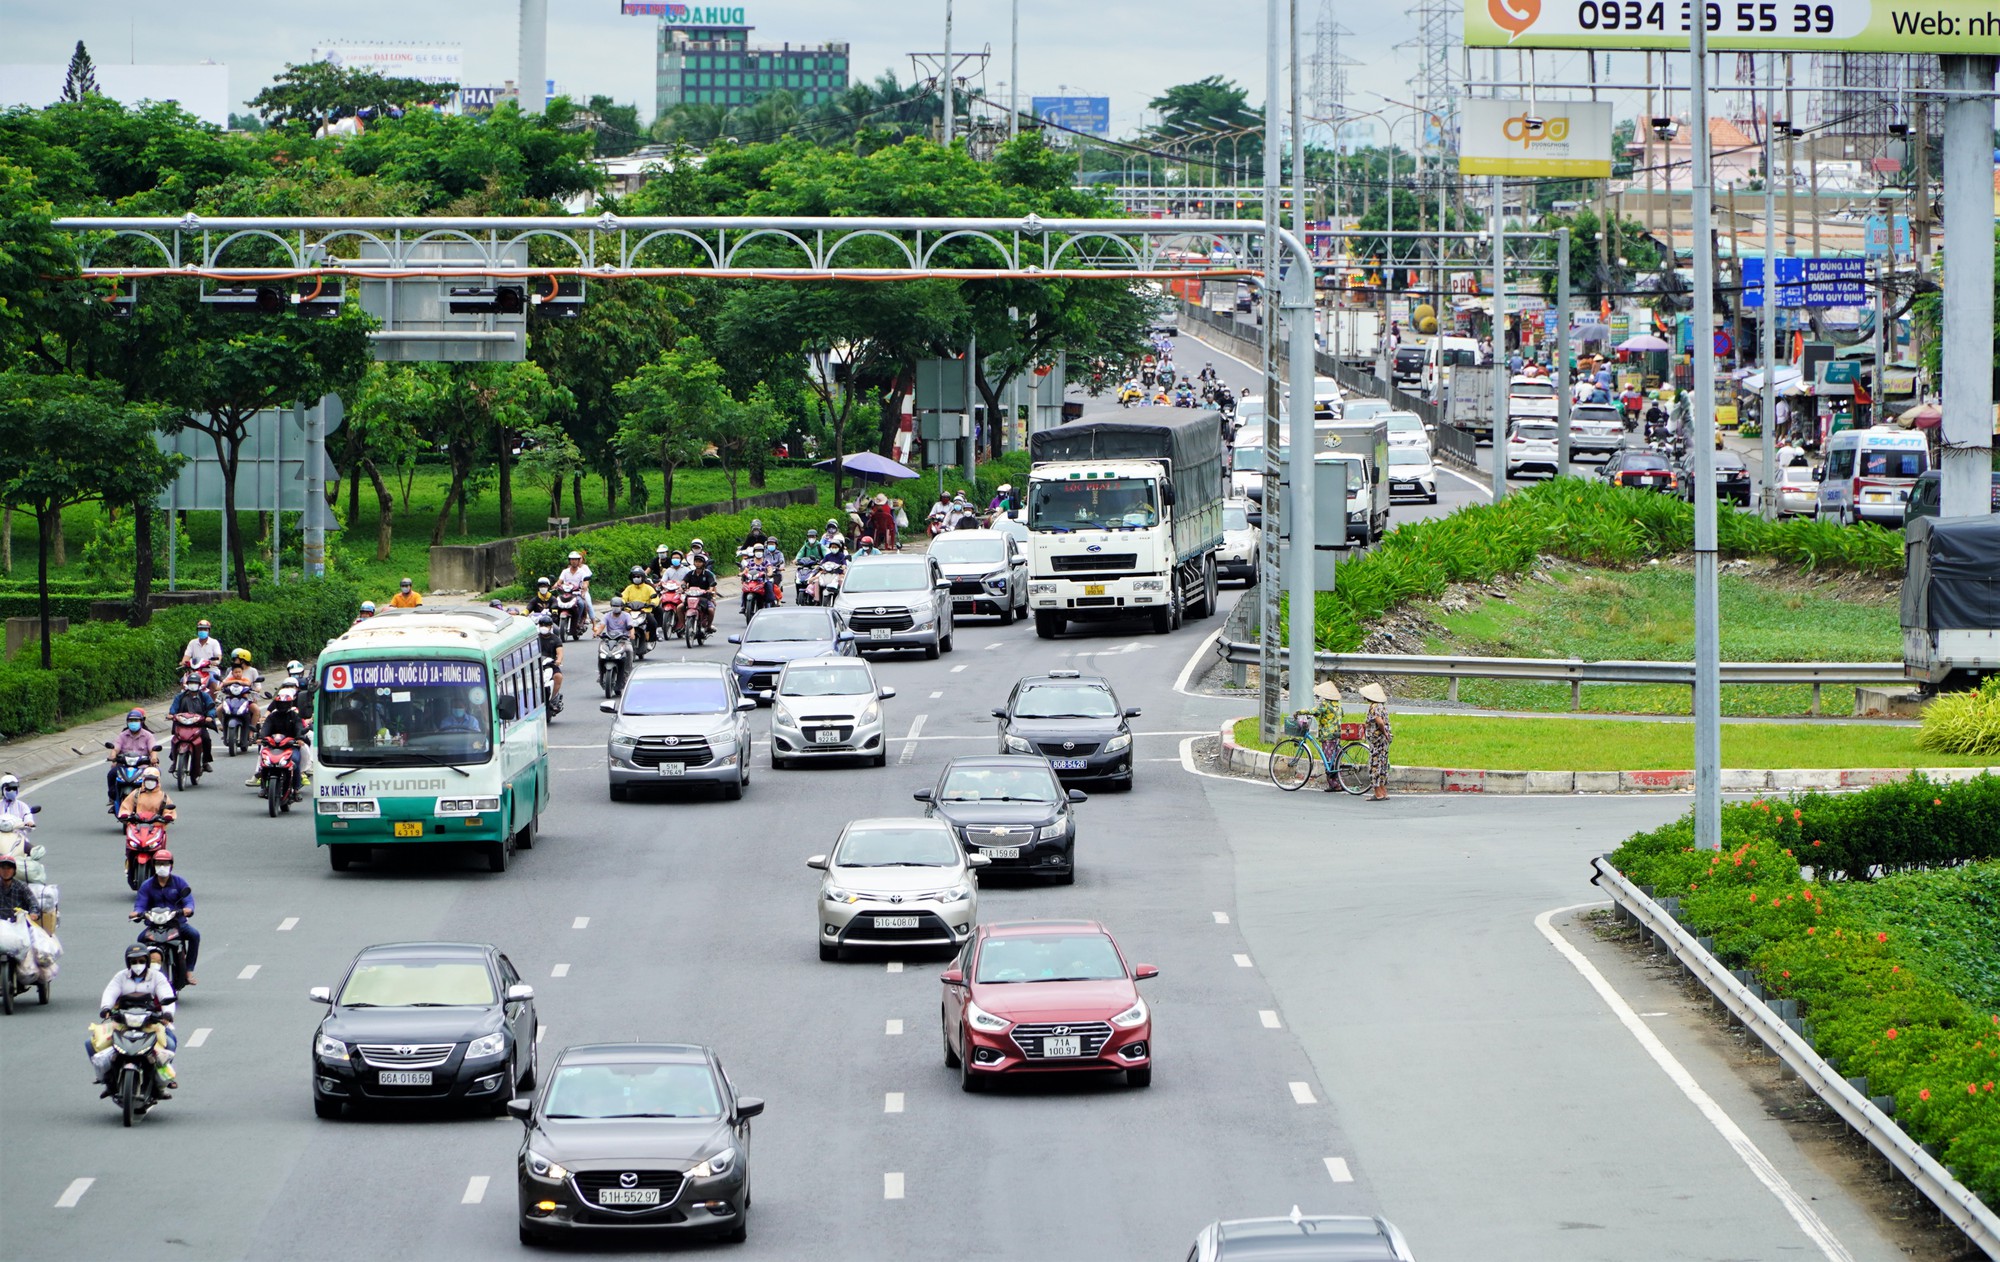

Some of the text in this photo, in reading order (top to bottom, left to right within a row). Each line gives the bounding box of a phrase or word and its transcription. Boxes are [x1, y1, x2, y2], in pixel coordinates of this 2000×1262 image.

[1578, 1, 1834, 33] 0934 39 55 39
[1892, 11, 1961, 36] Web:
[390, 53, 413, 61] LONG
[1809, 260, 1861, 271] ĐI ĐÚNG LÀN
[1837, 283, 1859, 293] VẠCH
[1807, 292, 1824, 302] SƠN
[1826, 293, 1843, 302] QUY
[1843, 293, 1863, 304] ĐỊNH
[1867, 437, 1922, 447] SOLATI
[332, 667, 347, 689] 9
[353, 668, 363, 684] BX
[364, 665, 379, 686] CHỢ
[398, 662, 417, 685] QUỐC
[419, 663, 428, 686] LỘ
[430, 667, 439, 683] 1A
[463, 666, 481, 683] LONG
[320, 785, 330, 797] BX
[352, 783, 366, 796] TÂY
[369, 779, 446, 791] HYUNDAI
[1054, 1038, 1070, 1047] 71A
[1049, 1046, 1077, 1056] 100.97
[601, 1191, 658, 1203] 51H-552.97
